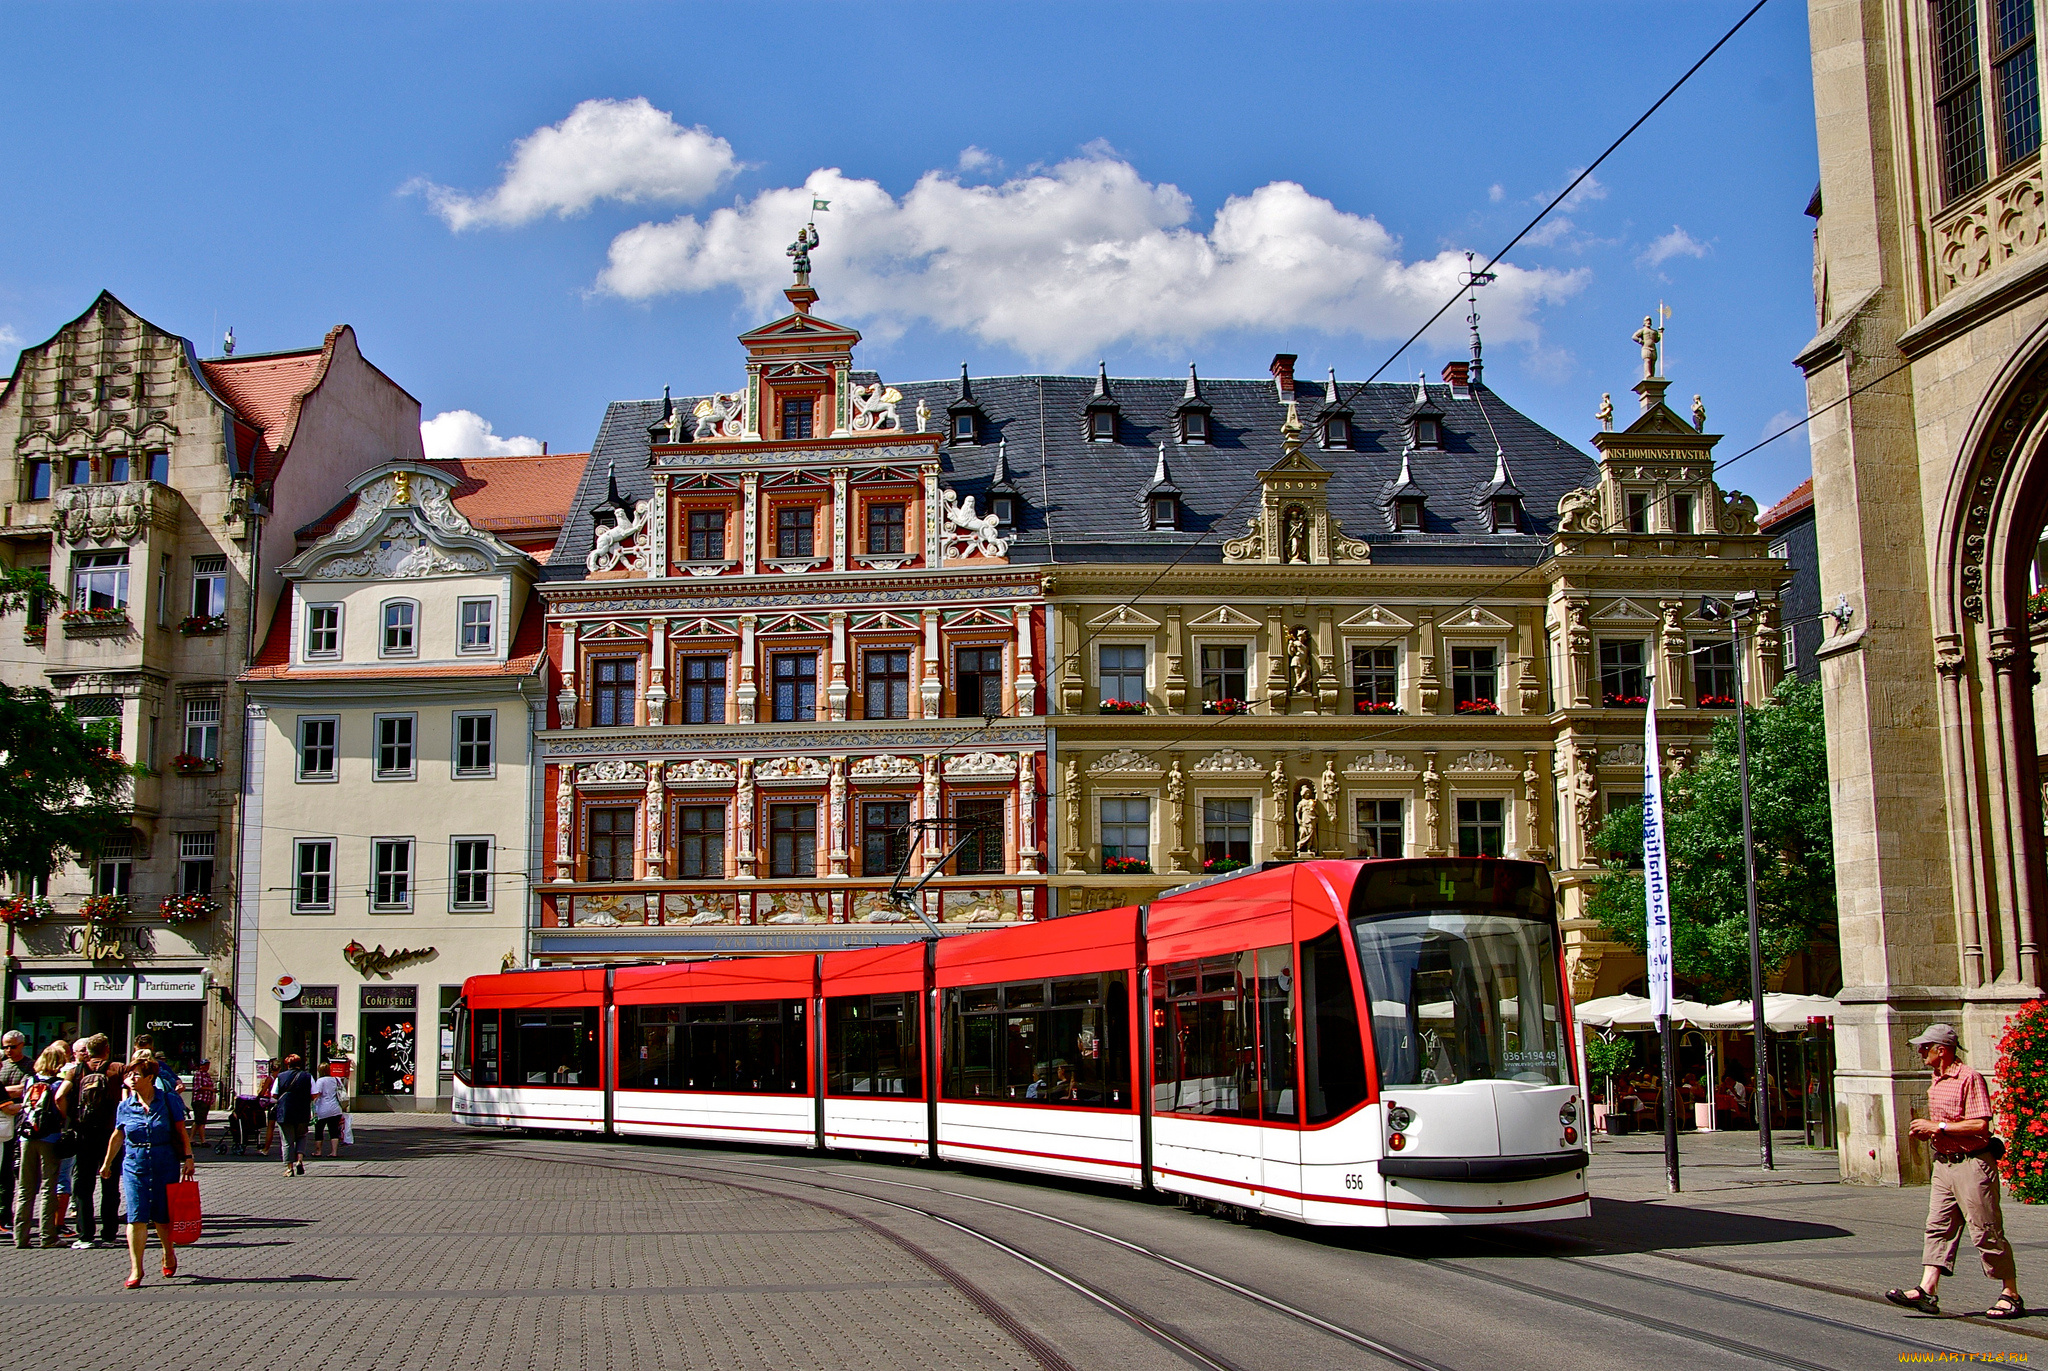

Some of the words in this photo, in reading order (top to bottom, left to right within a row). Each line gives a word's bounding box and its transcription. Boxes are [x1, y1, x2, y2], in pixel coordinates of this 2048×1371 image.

[1274, 482, 1318, 490] 1892
[1439, 872, 1456, 901] 4
[714, 937, 747, 949] ZVM
[756, 936, 820, 948] BREITEN
[28, 981, 69, 991] Kosmetik
[93, 981, 125, 991] Friseur
[145, 981, 196, 992] Parfümerie
[1345, 1173, 1364, 1190] 656
